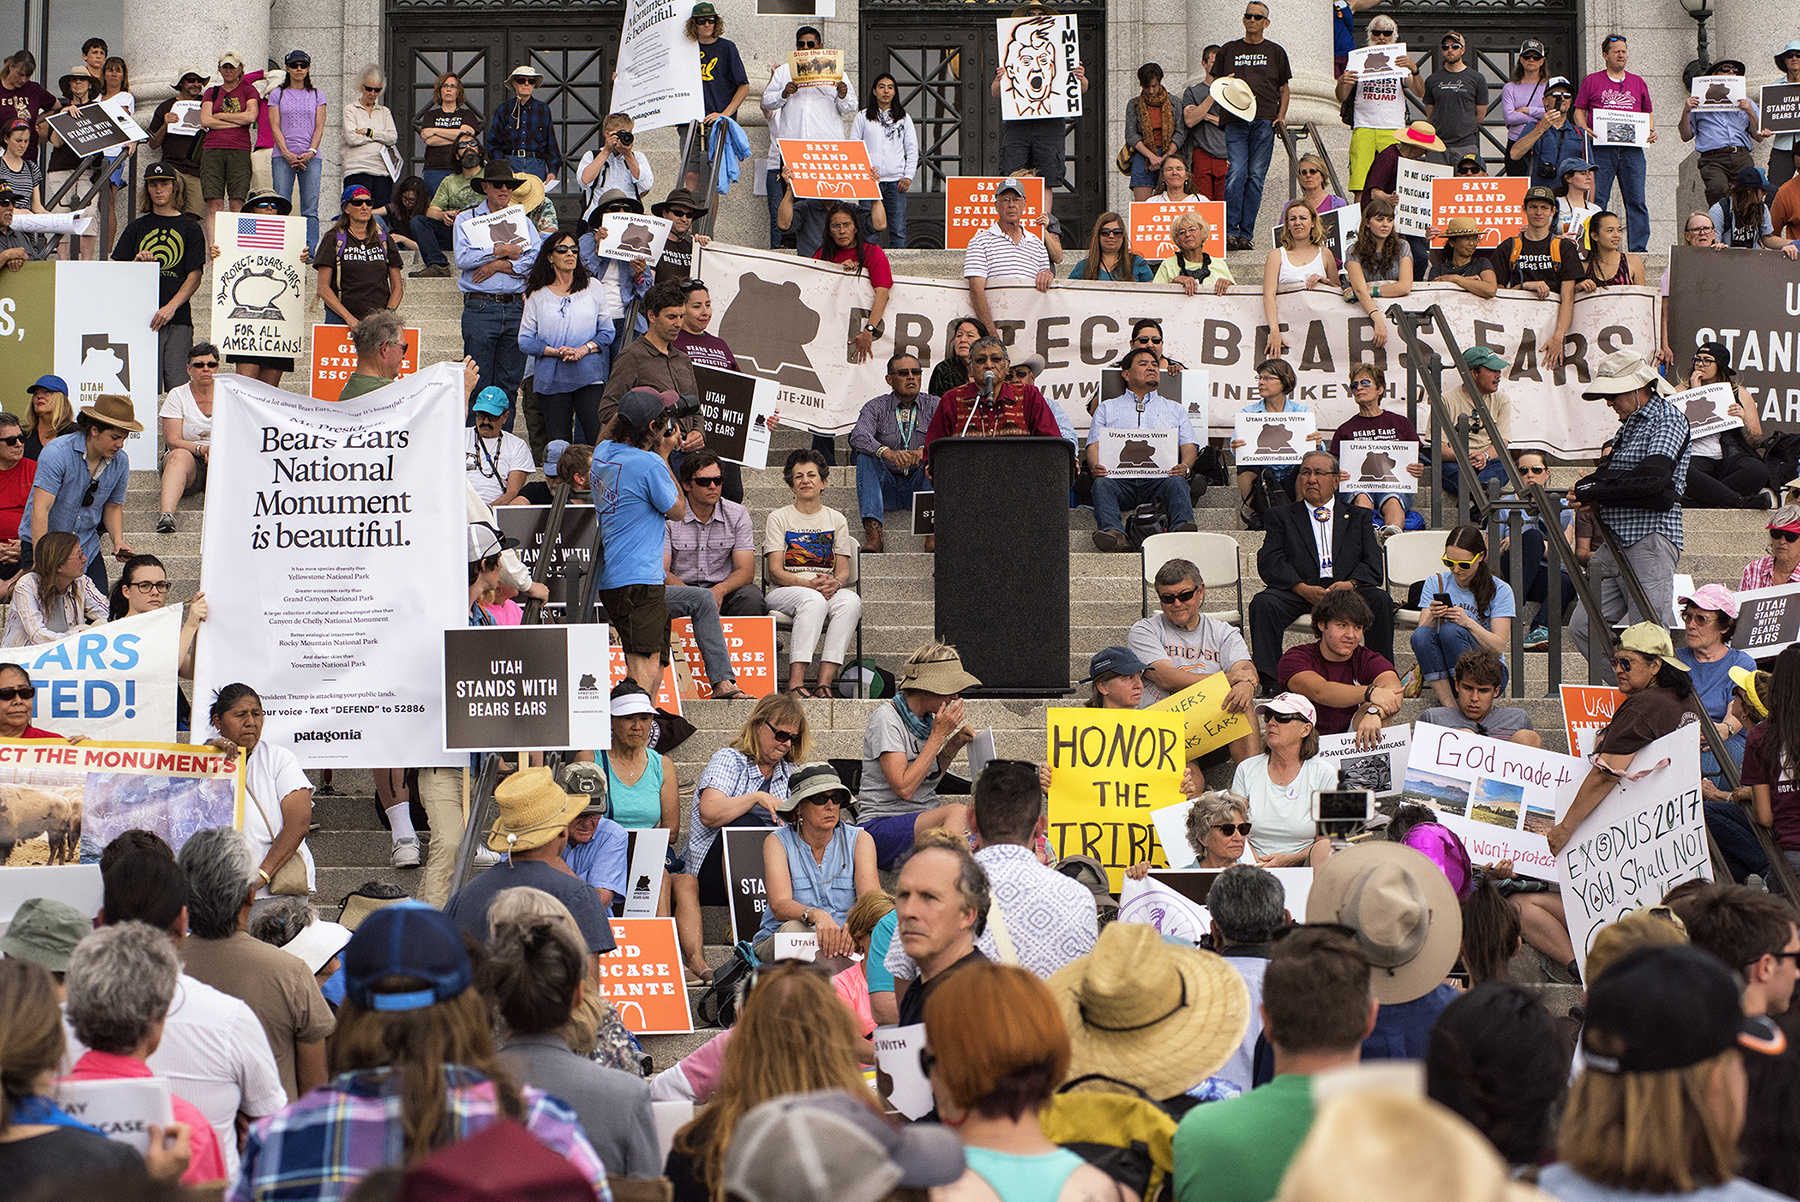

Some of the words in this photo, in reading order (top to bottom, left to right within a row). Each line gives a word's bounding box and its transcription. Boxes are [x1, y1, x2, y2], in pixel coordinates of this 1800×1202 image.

[633, 5, 676, 39] beautiful.
[1061, 16, 1080, 114] IMPEACH
[1363, 86, 1397, 94] RESIST
[1363, 94, 1397, 102] TRUMP
[1766, 104, 1796, 112] STANDS
[66, 127, 95, 140] STANDS
[94, 120, 113, 134] WITH
[792, 162, 866, 171] STAIRCASE
[794, 172, 870, 180] ESCALANTE
[1462, 182, 1498, 190] SAVE
[1454, 194, 1506, 202] GRAND
[1438, 206, 1521, 214] STAIRCASE
[472, 218, 486, 227] UTAH
[487, 212, 506, 224] STANDS
[508, 208, 522, 217] WITH
[630, 216, 652, 224] STANDS
[652, 220, 666, 228] WITH
[344, 254, 367, 262] BEARS
[664, 254, 682, 266] BEARS
[234, 324, 254, 336] FOR
[260, 325, 282, 338] ALL
[686, 345, 708, 354] BEARS
[708, 348, 725, 356] EARS
[694, 358, 728, 368] PROTECTED
[80, 382, 104, 392] UTAH
[1685, 389, 1706, 399] STANDS
[1708, 386, 1724, 394] WITH
[706, 390, 726, 404] UTAH
[280, 401, 297, 410] about
[298, 404, 314, 412] Bears
[290, 416, 314, 428] Mr.
[722, 408, 744, 425] WITH
[715, 423, 736, 437] EARS
[260, 426, 338, 453] Bears
[343, 429, 410, 449] Ears
[272, 454, 394, 484] National
[253, 490, 412, 518] Monument
[252, 524, 270, 550] is
[276, 520, 412, 548] beautiful.
[288, 573, 326, 581] Yellowstone
[1757, 598, 1787, 612] UTAH
[1754, 608, 1785, 619] STANDS
[302, 616, 323, 625] Chelly
[1758, 617, 1778, 626] WITH
[1752, 624, 1780, 635] BEARS
[1749, 632, 1778, 646] EARS
[490, 660, 522, 674] UTAH
[456, 680, 516, 698] STANDS
[522, 679, 558, 696] WITH
[316, 692, 344, 700] attacking
[358, 691, 377, 699] public
[278, 708, 302, 716] voice
[310, 706, 328, 714] Text
[382, 705, 392, 713] to
[394, 704, 426, 713] 52886
[468, 702, 510, 716] BEARS
[514, 701, 546, 716] EARS
[1204, 714, 1239, 738] EARS
[294, 729, 362, 743] patagonia
[1054, 722, 1176, 772] HONOR
[34, 748, 78, 765] THE
[84, 750, 236, 774] MONUMENTS
[1436, 732, 1496, 773] God
[1503, 761, 1552, 788] made
[1092, 781, 1152, 808] THE
[1567, 812, 1651, 880] EXODUS
[1653, 790, 1700, 840] 20:17
[1513, 850, 1557, 869] protect
[1572, 871, 1616, 919] YOU
[1620, 848, 1670, 896] Shall
[1672, 826, 1705, 870] NOT
[790, 939, 814, 947] UTAH
[880, 1040, 907, 1050] WITH
